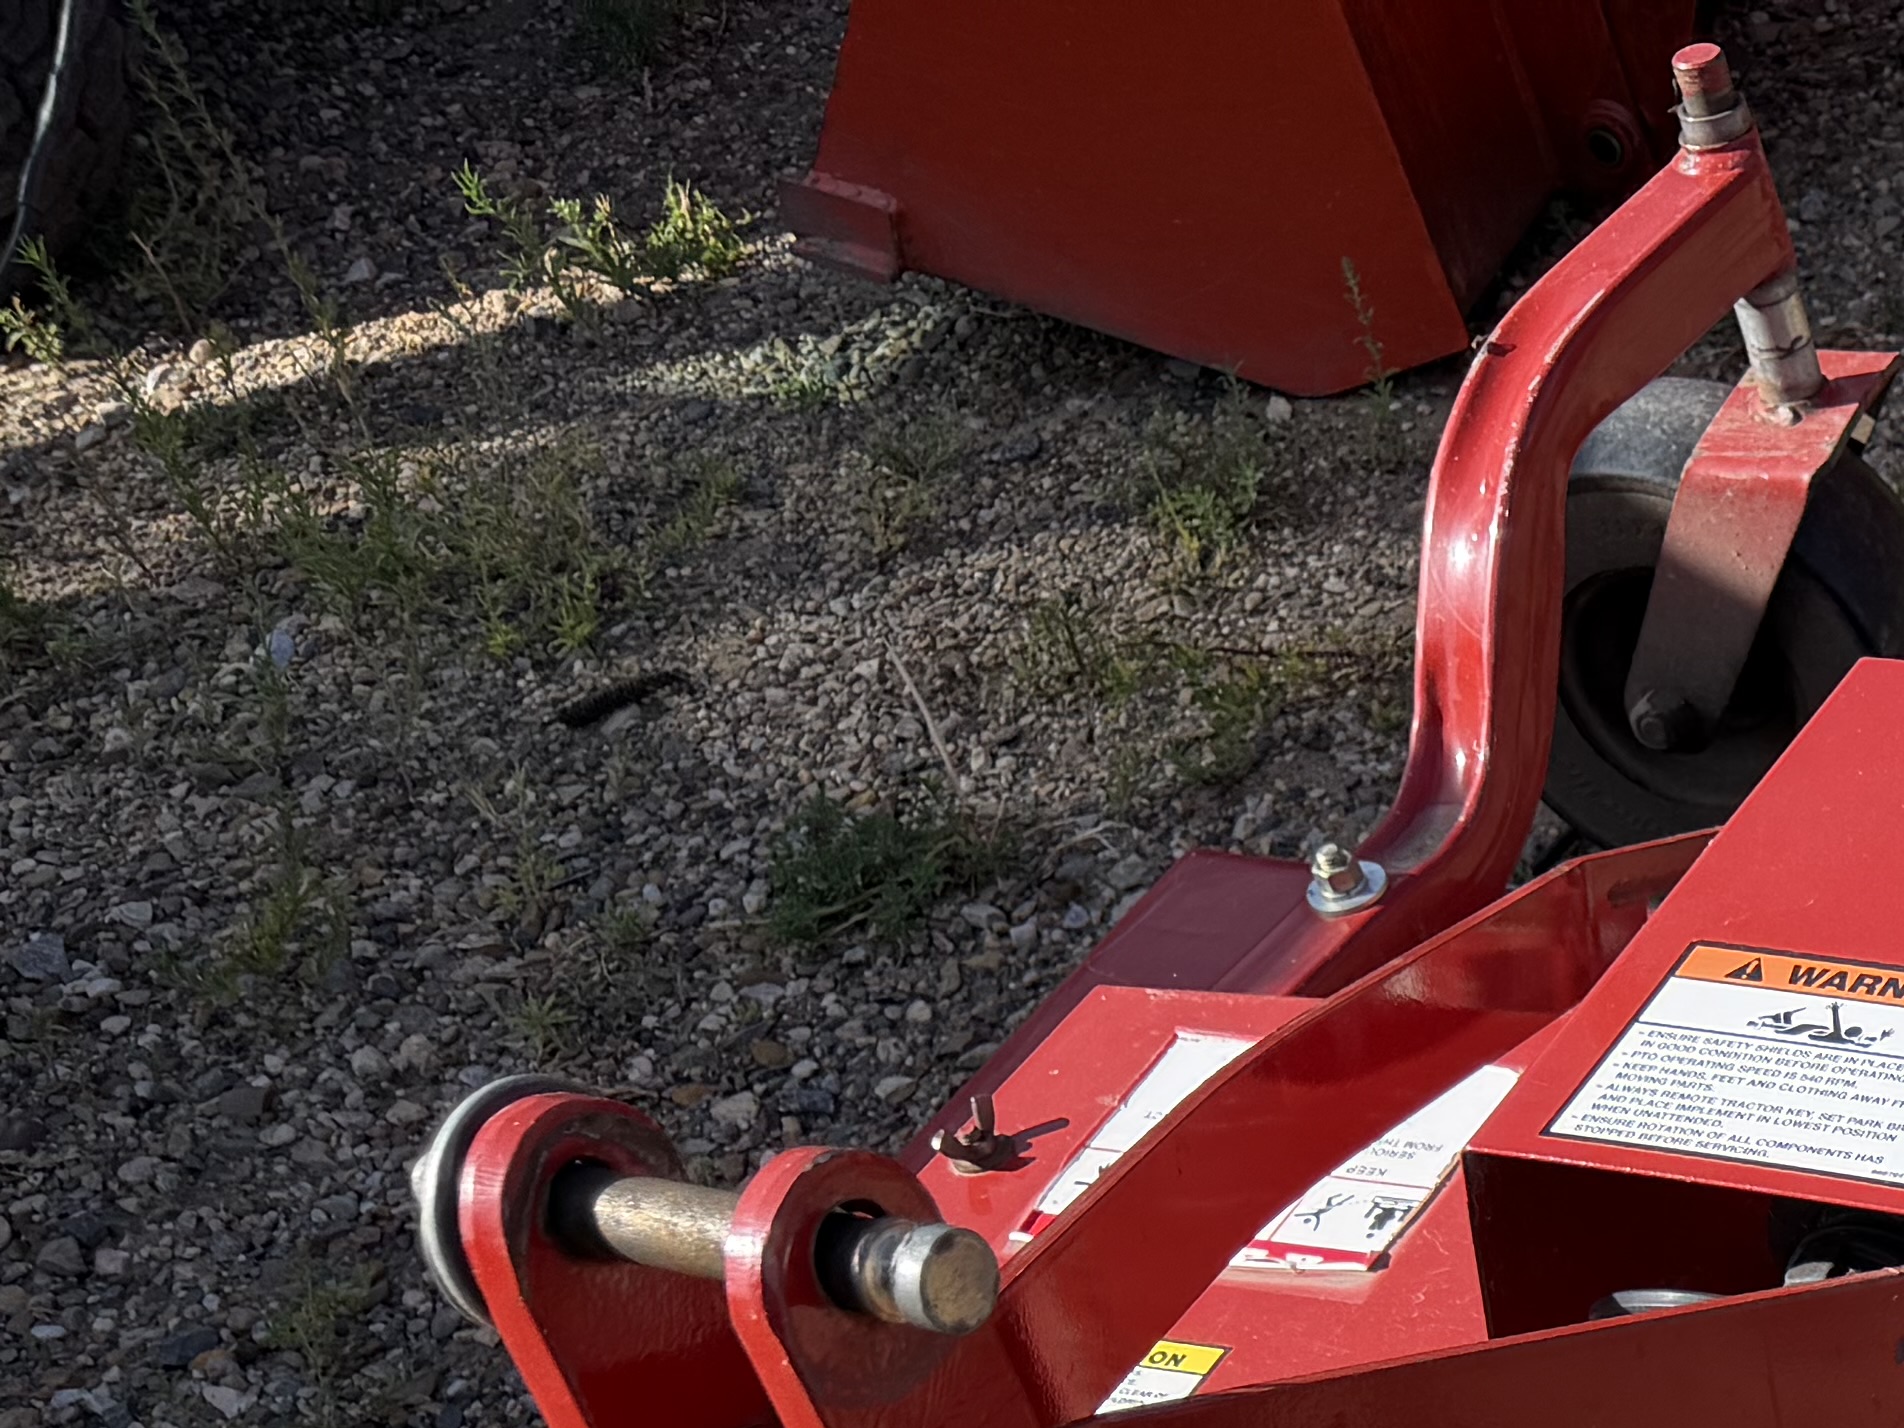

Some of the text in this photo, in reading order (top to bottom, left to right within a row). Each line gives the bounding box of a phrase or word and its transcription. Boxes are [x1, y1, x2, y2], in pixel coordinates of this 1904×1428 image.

[1639, 1038, 1830, 1073] IN GOOD CONDITION BEFORE
[1646, 1029, 1701, 1044] ENSURE
[1701, 1036, 1754, 1050] SAFETY
[1753, 1043, 1813, 1059] SHIELDS
[1812, 1051, 1843, 1064] ARE
[1841, 1055, 1860, 1065] IN
[1614, 1070, 1668, 1086] MOVING
[1629, 1049, 1659, 1061] PTO
[1659, 1053, 1736, 1072] OPERATING
[1735, 1063, 1783, 1078] SPEED
[1782, 1070, 1798, 1080] IS
[1621, 1061, 1658, 1072] KEEP
[1709, 1072, 1747, 1086] FEET
[1745, 1078, 1777, 1089] AND
[1777, 1082, 1848, 1100] CLOTHING
[1848, 1092, 1891, 1106] AWAY
[1590, 1101, 1632, 1115] WHEN
[1596, 1092, 1898, 1143] AND PLACE IMPLEMENT IN LOWEST POSITION
[1604, 1082, 1660, 1098] ALWAYS
[1659, 1089, 1719, 1106] REMOTE
[1719, 1096, 1784, 1114] TRACTOR
[1816, 1111, 1846, 1123] SET
[1845, 1115, 1884, 1129] PARK
[1404, 1140, 1444, 1153] FROM
[1573, 1123, 1636, 1139] STOPPED
[1636, 1131, 1694, 1147] BEFORE
[1579, 1112, 1885, 1165] ENSURE ROTATION OF ALL COMPONENTS HAS
[1345, 1164, 1388, 1177] KEEP
[1148, 1350, 1187, 1367] ON
